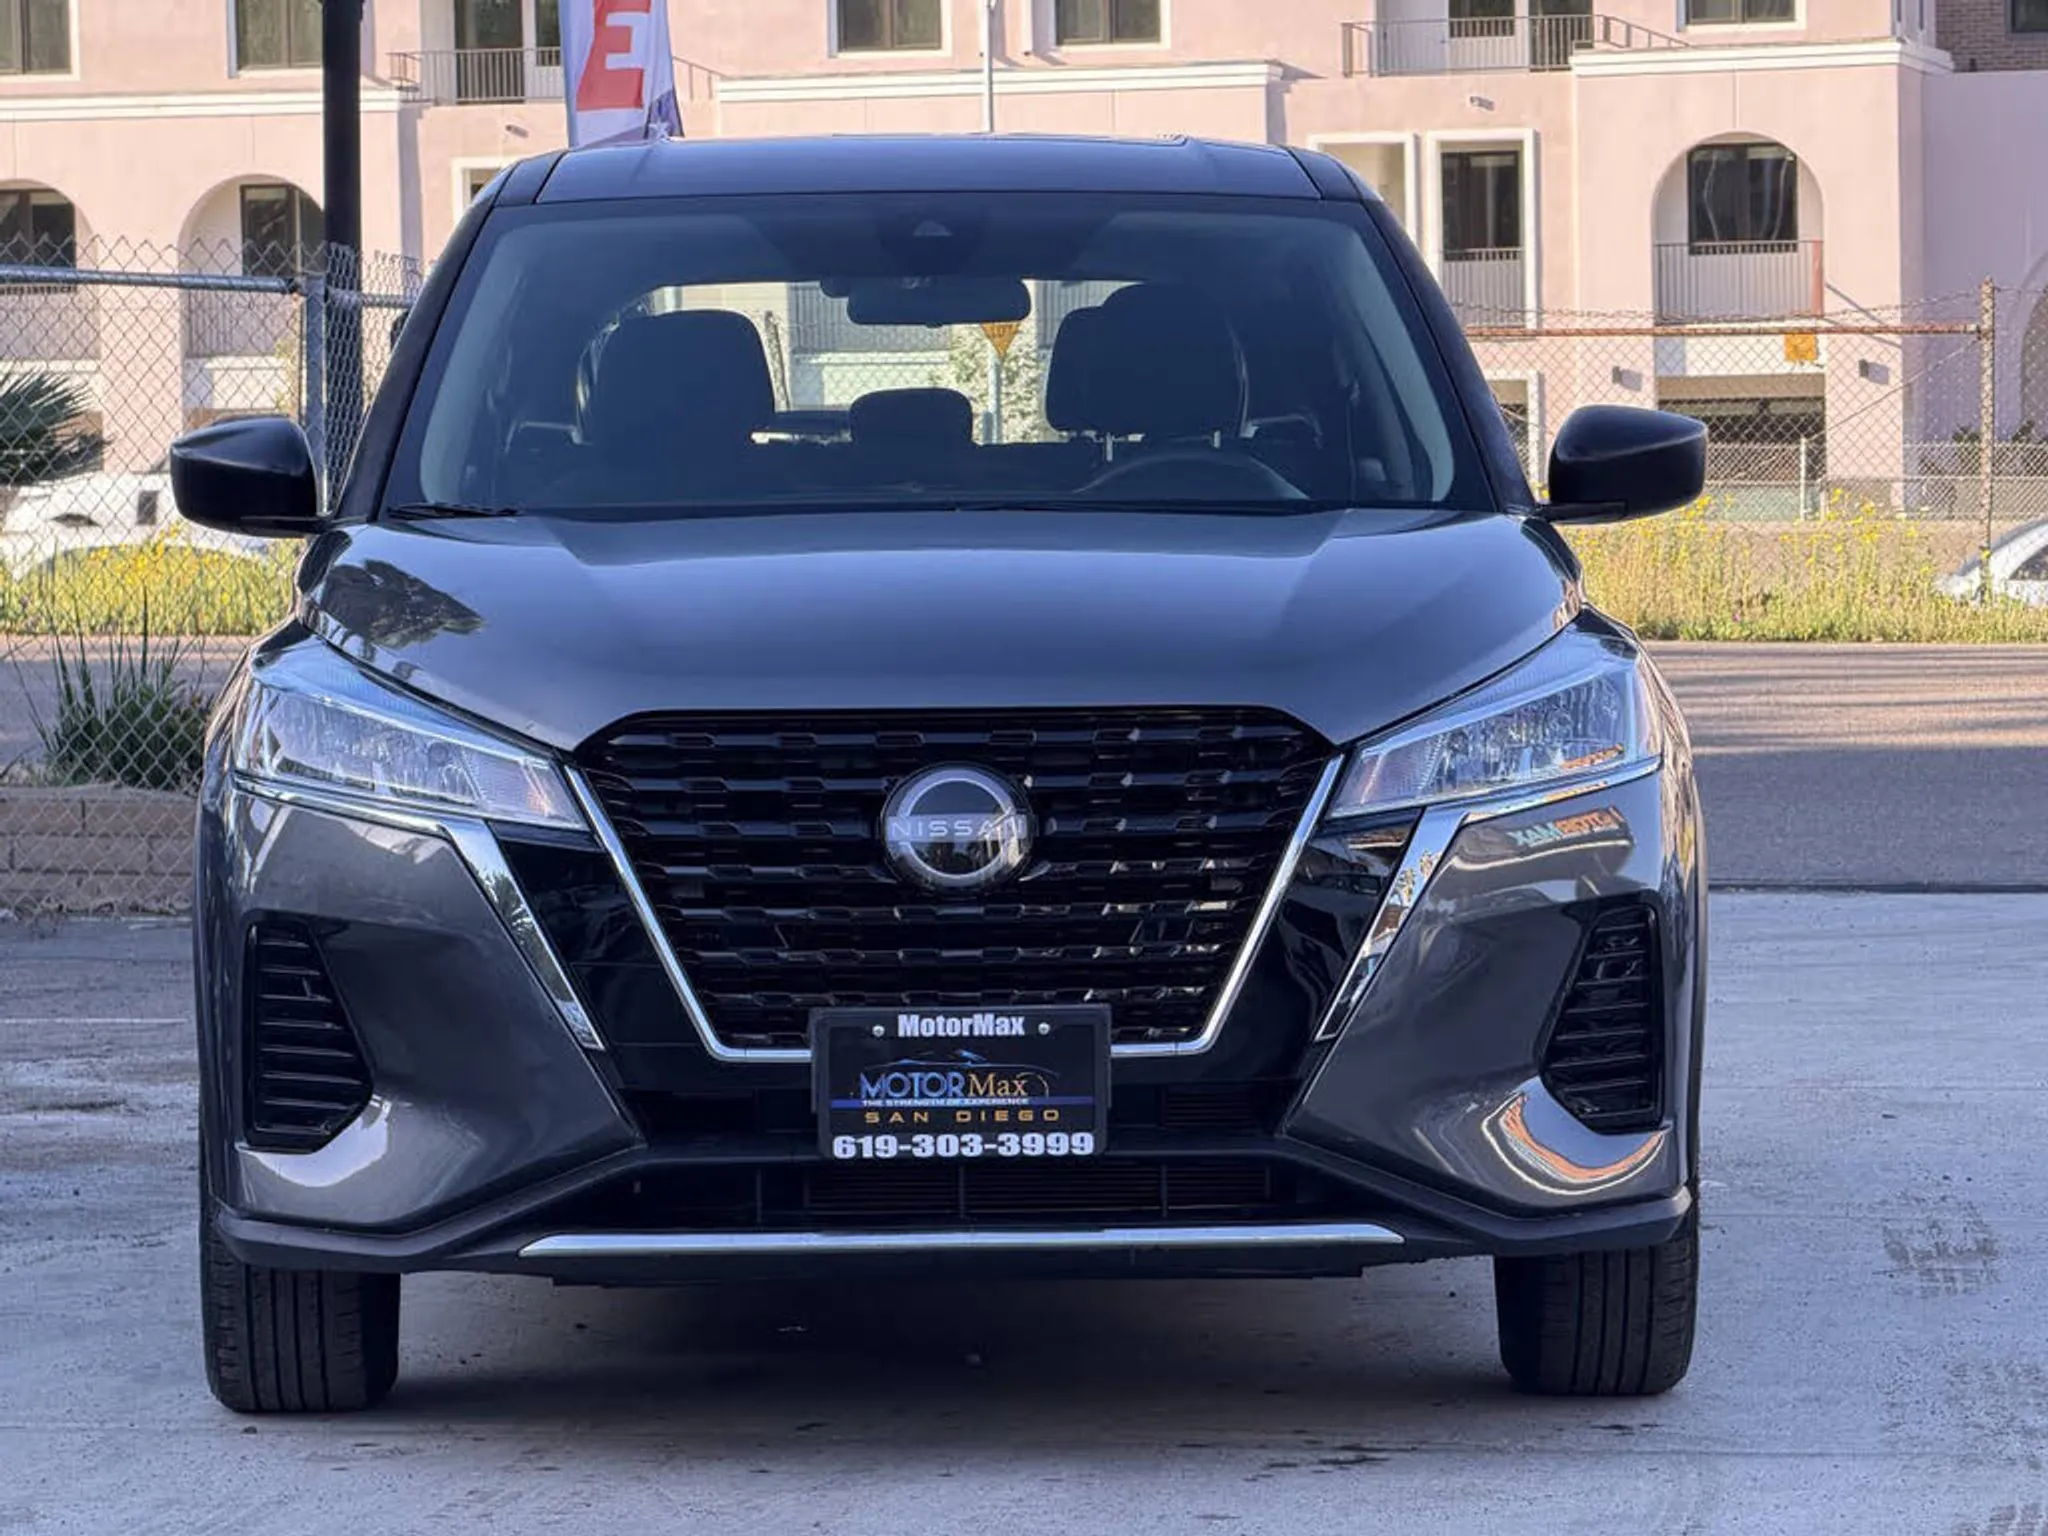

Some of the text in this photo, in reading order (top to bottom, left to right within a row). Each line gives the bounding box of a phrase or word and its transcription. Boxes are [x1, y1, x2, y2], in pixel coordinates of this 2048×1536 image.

[575, 0, 652, 111] E
[891, 818, 1024, 838] NISSAN
[898, 1013, 1025, 1038] MotorMax
[859, 1071, 1028, 1100] MOTOR Max
[864, 1109, 1060, 1124] SAN DIEGO
[832, 1131, 1095, 1160] 619-303-3999
